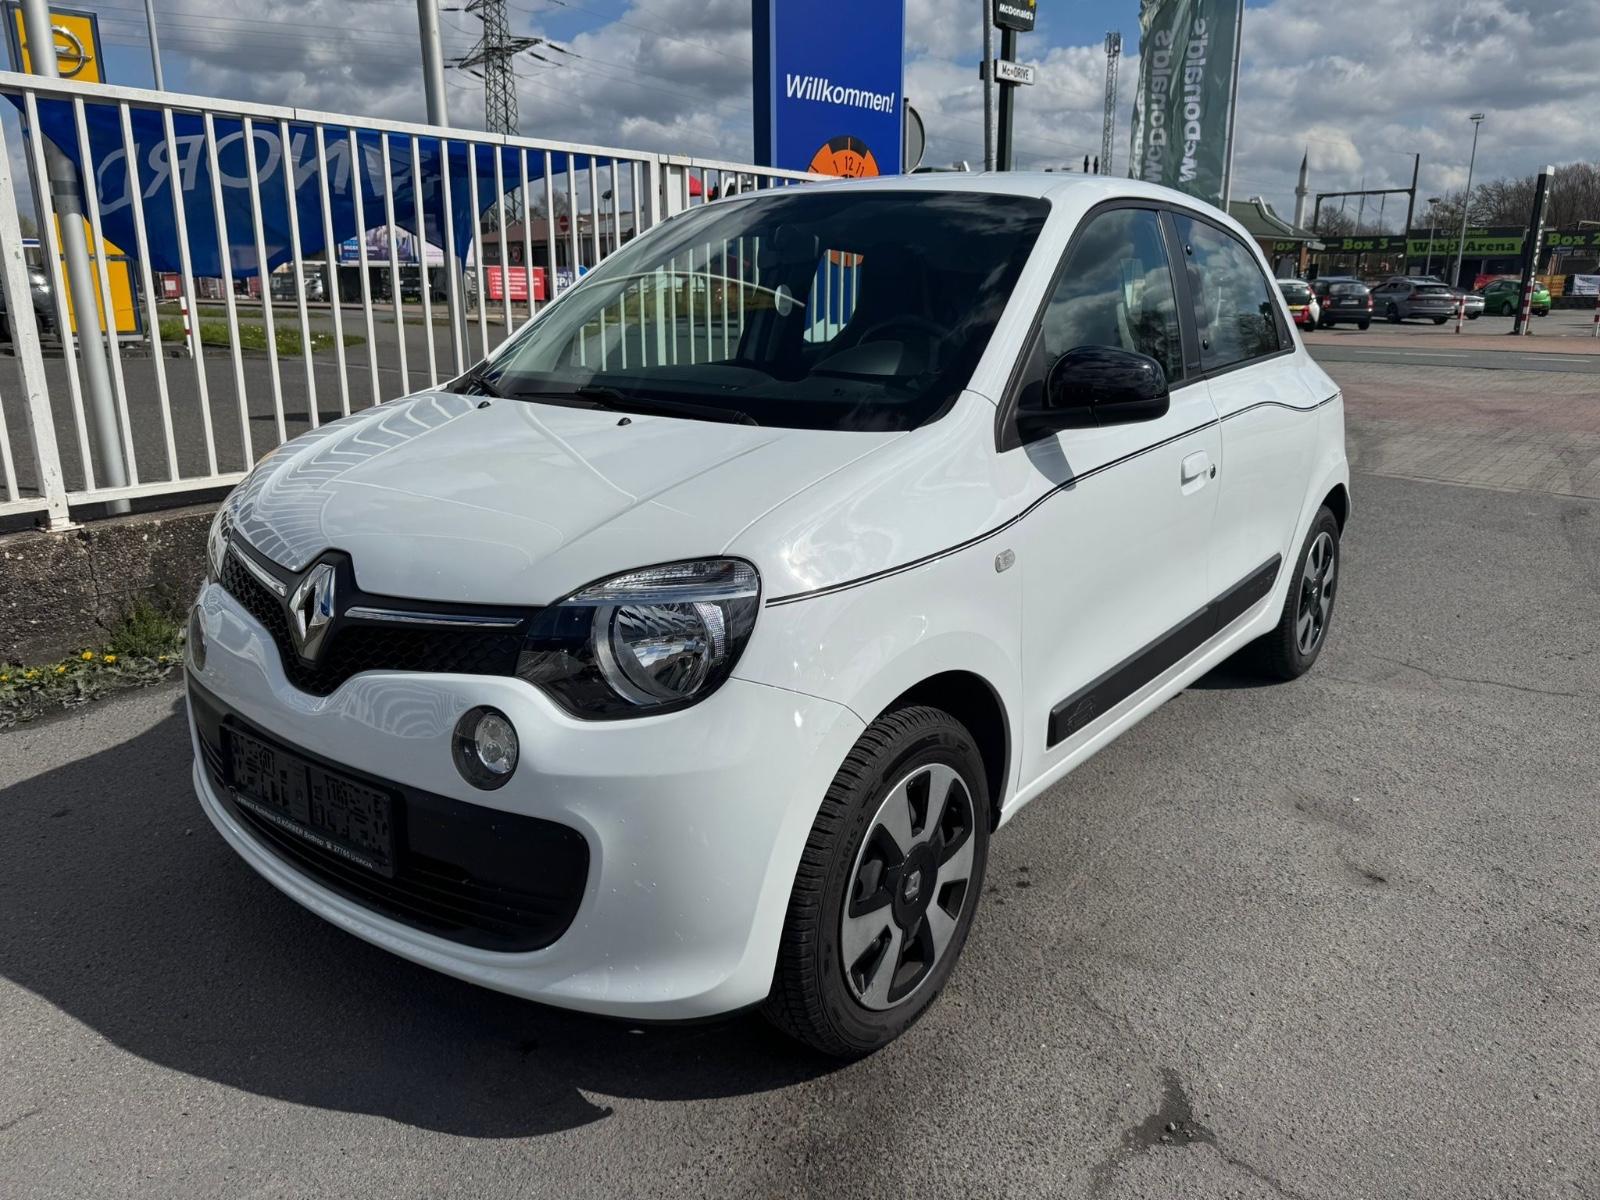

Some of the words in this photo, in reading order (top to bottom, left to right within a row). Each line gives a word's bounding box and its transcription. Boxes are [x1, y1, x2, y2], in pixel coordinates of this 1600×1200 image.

[999, 3, 1034, 21] McDonald's
[786, 73, 895, 113] Willkommen!
[845, 156, 854, 171] 12
[1342, 238, 1374, 250] Box
[1379, 238, 1389, 249] 3
[1464, 241, 1516, 252] Arena
[1547, 233, 1586, 246] Box
[1592, 233, 1600, 245] 2
